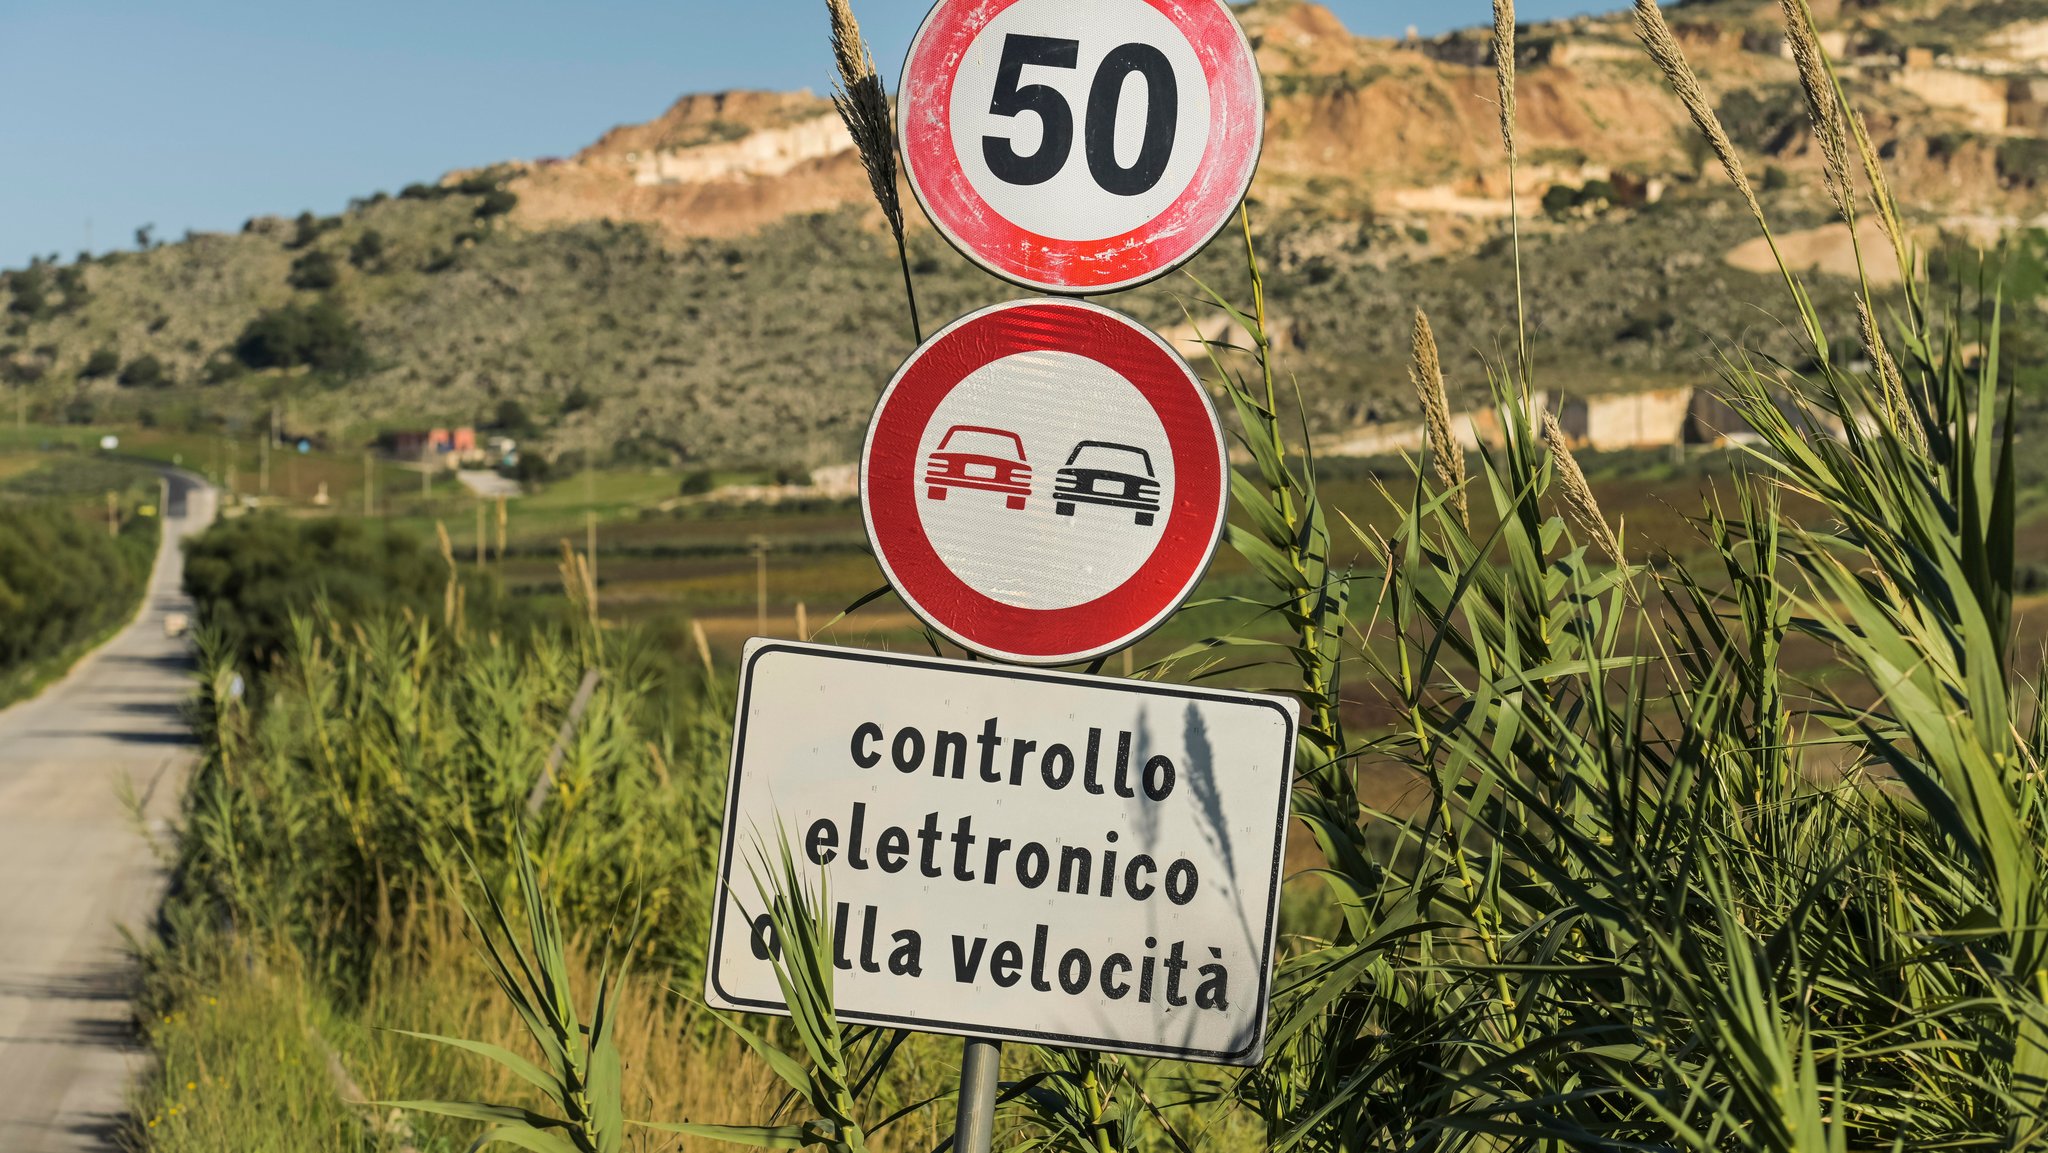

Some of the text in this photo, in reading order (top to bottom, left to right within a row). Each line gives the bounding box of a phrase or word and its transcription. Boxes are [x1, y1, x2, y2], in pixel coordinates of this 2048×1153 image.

[982, 33, 1179, 196] 50
[851, 717, 1176, 802] controllo
[805, 802, 1199, 906] elettronico
[751, 895, 1230, 1012] dlla velocità
